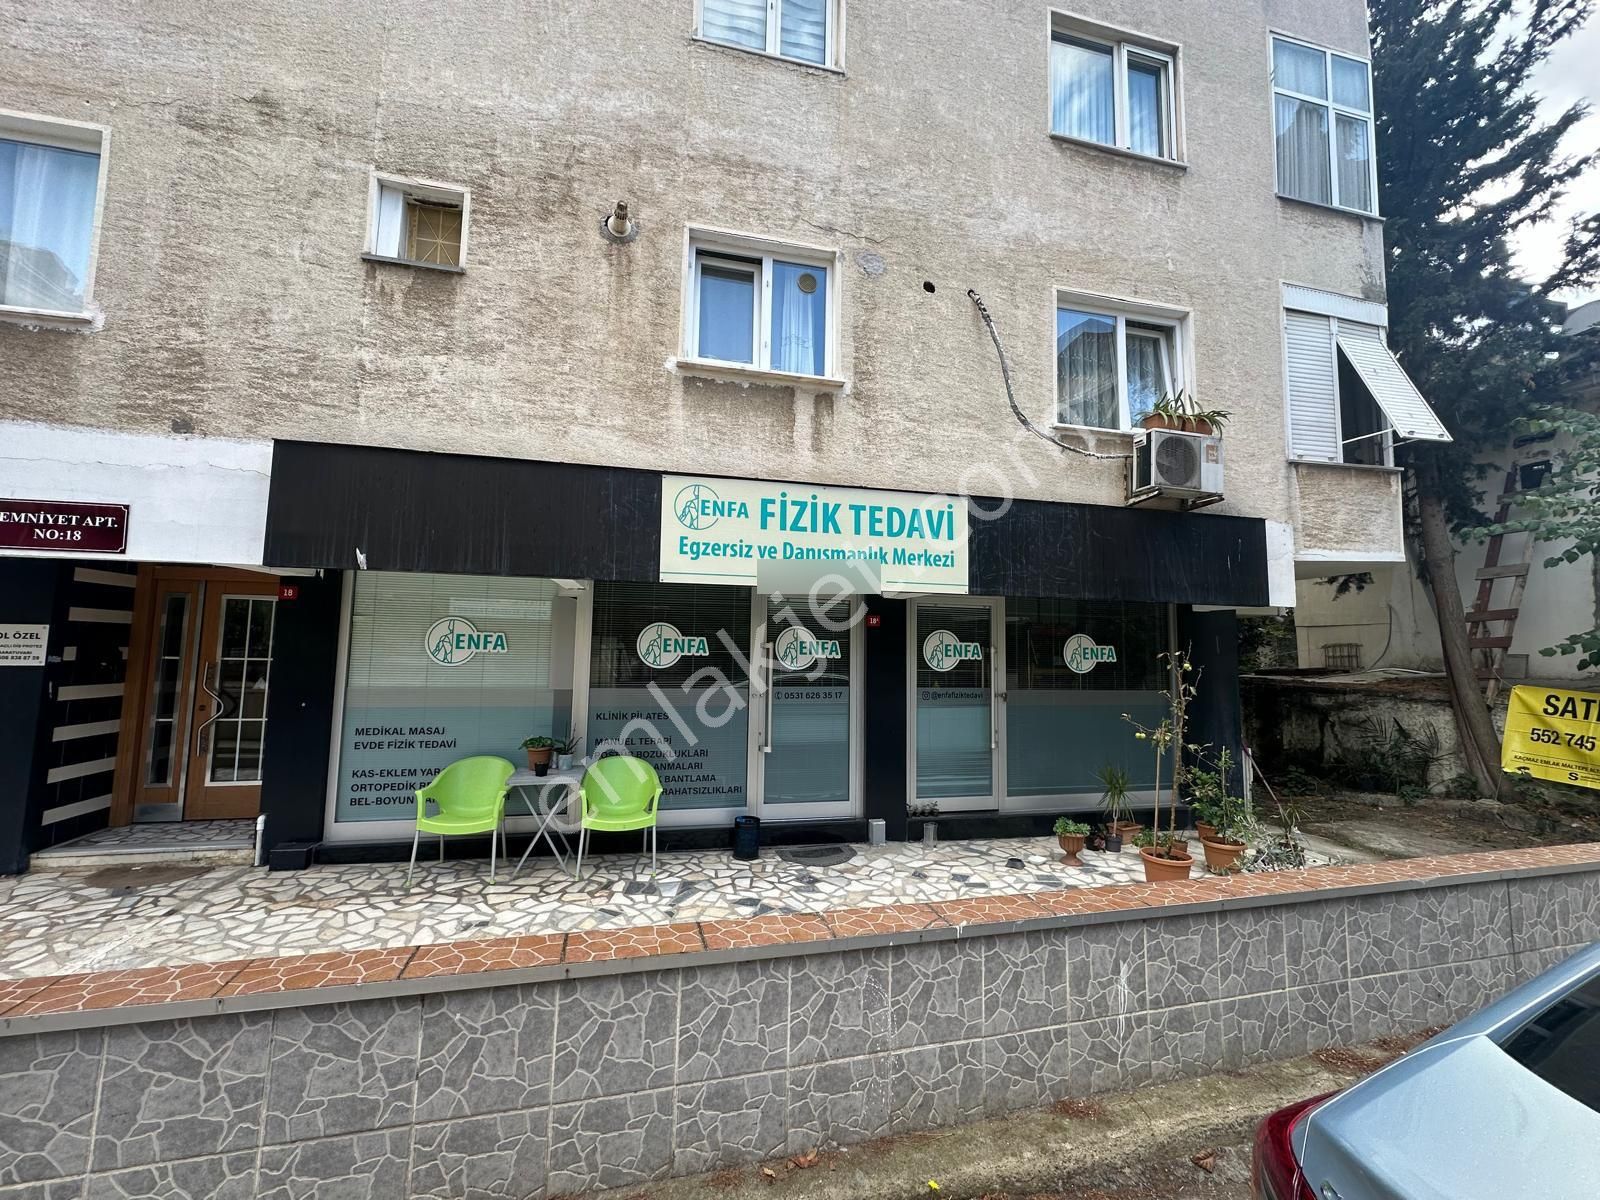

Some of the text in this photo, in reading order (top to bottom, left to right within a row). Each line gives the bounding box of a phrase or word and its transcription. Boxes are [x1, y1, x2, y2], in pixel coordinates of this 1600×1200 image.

[0, 511, 118, 528] EMNİYET APT.
[700, 491, 954, 541] ENFA FİZİK TEDAVİ
[33, 528, 82, 541] NO:18
[679, 535, 753, 560] Egzersiz
[757, 544, 778, 559] ve
[892, 546, 955, 568] Merkezi
[283, 588, 293, 597] 18
[13, 630, 41, 640] ÖZEL
[455, 633, 506, 651] ENFA
[663, 637, 709, 655] ENFA
[799, 640, 840, 656] ENFA
[944, 643, 982, 659] ENFA
[1082, 646, 1116, 660] ENFA
[784, 691, 843, 700] 0531 626 35 17
[931, 690, 984, 700] @enfafiziktedavi
[595, 710, 670, 721] KLİNİK PİLATES
[354, 725, 446, 736] MEDİKAL MASAJ
[354, 737, 457, 750] EVDE FİZİK TEDAVİ
[594, 736, 672, 746] MANUEL TERAPİ
[1530, 727, 1597, 752] 552 745
[637, 748, 709, 758] BOZUKLUKLARI
[654, 761, 703, 771] ANMALARI
[1540, 759, 1560, 767] EMLAK
[351, 768, 418, 779] KAS-EKLEM
[664, 774, 716, 783] BANTLAMA
[350, 782, 417, 792] ORTOPEDİK
[662, 785, 742, 796] RAHATSIZLIKLARI
[349, 796, 414, 807] BEL-BOYUN
